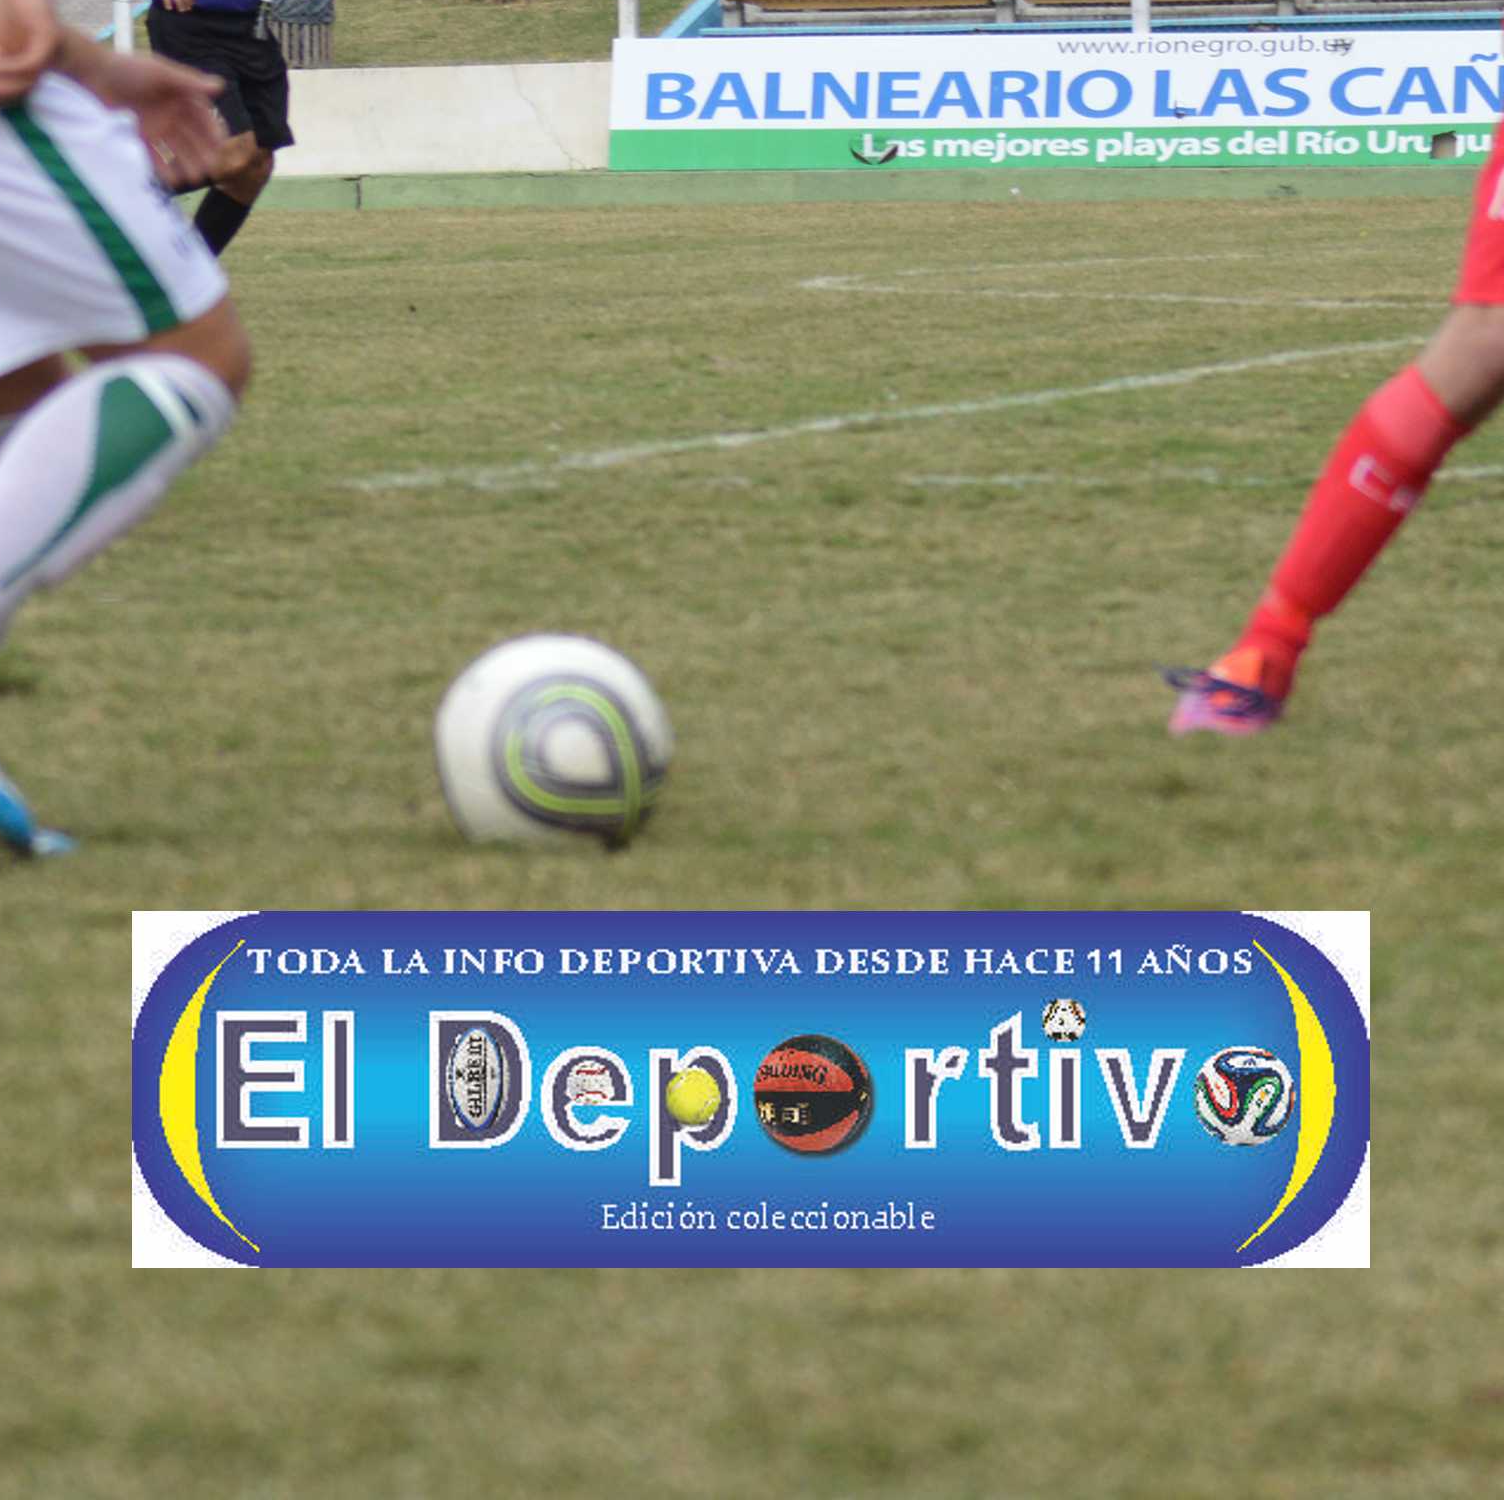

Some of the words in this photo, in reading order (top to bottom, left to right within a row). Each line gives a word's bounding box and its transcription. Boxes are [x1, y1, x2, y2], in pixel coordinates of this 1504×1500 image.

[1056, 34, 1355, 58] www.rionegro.gub.uy
[645, 68, 1133, 121] BALNEARIO
[1153, 66, 1311, 118] LAS
[933, 133, 1089, 163] mejores
[1096, 131, 1221, 163] playas
[1227, 130, 1288, 156] del
[1295, 130, 1361, 155] Río
